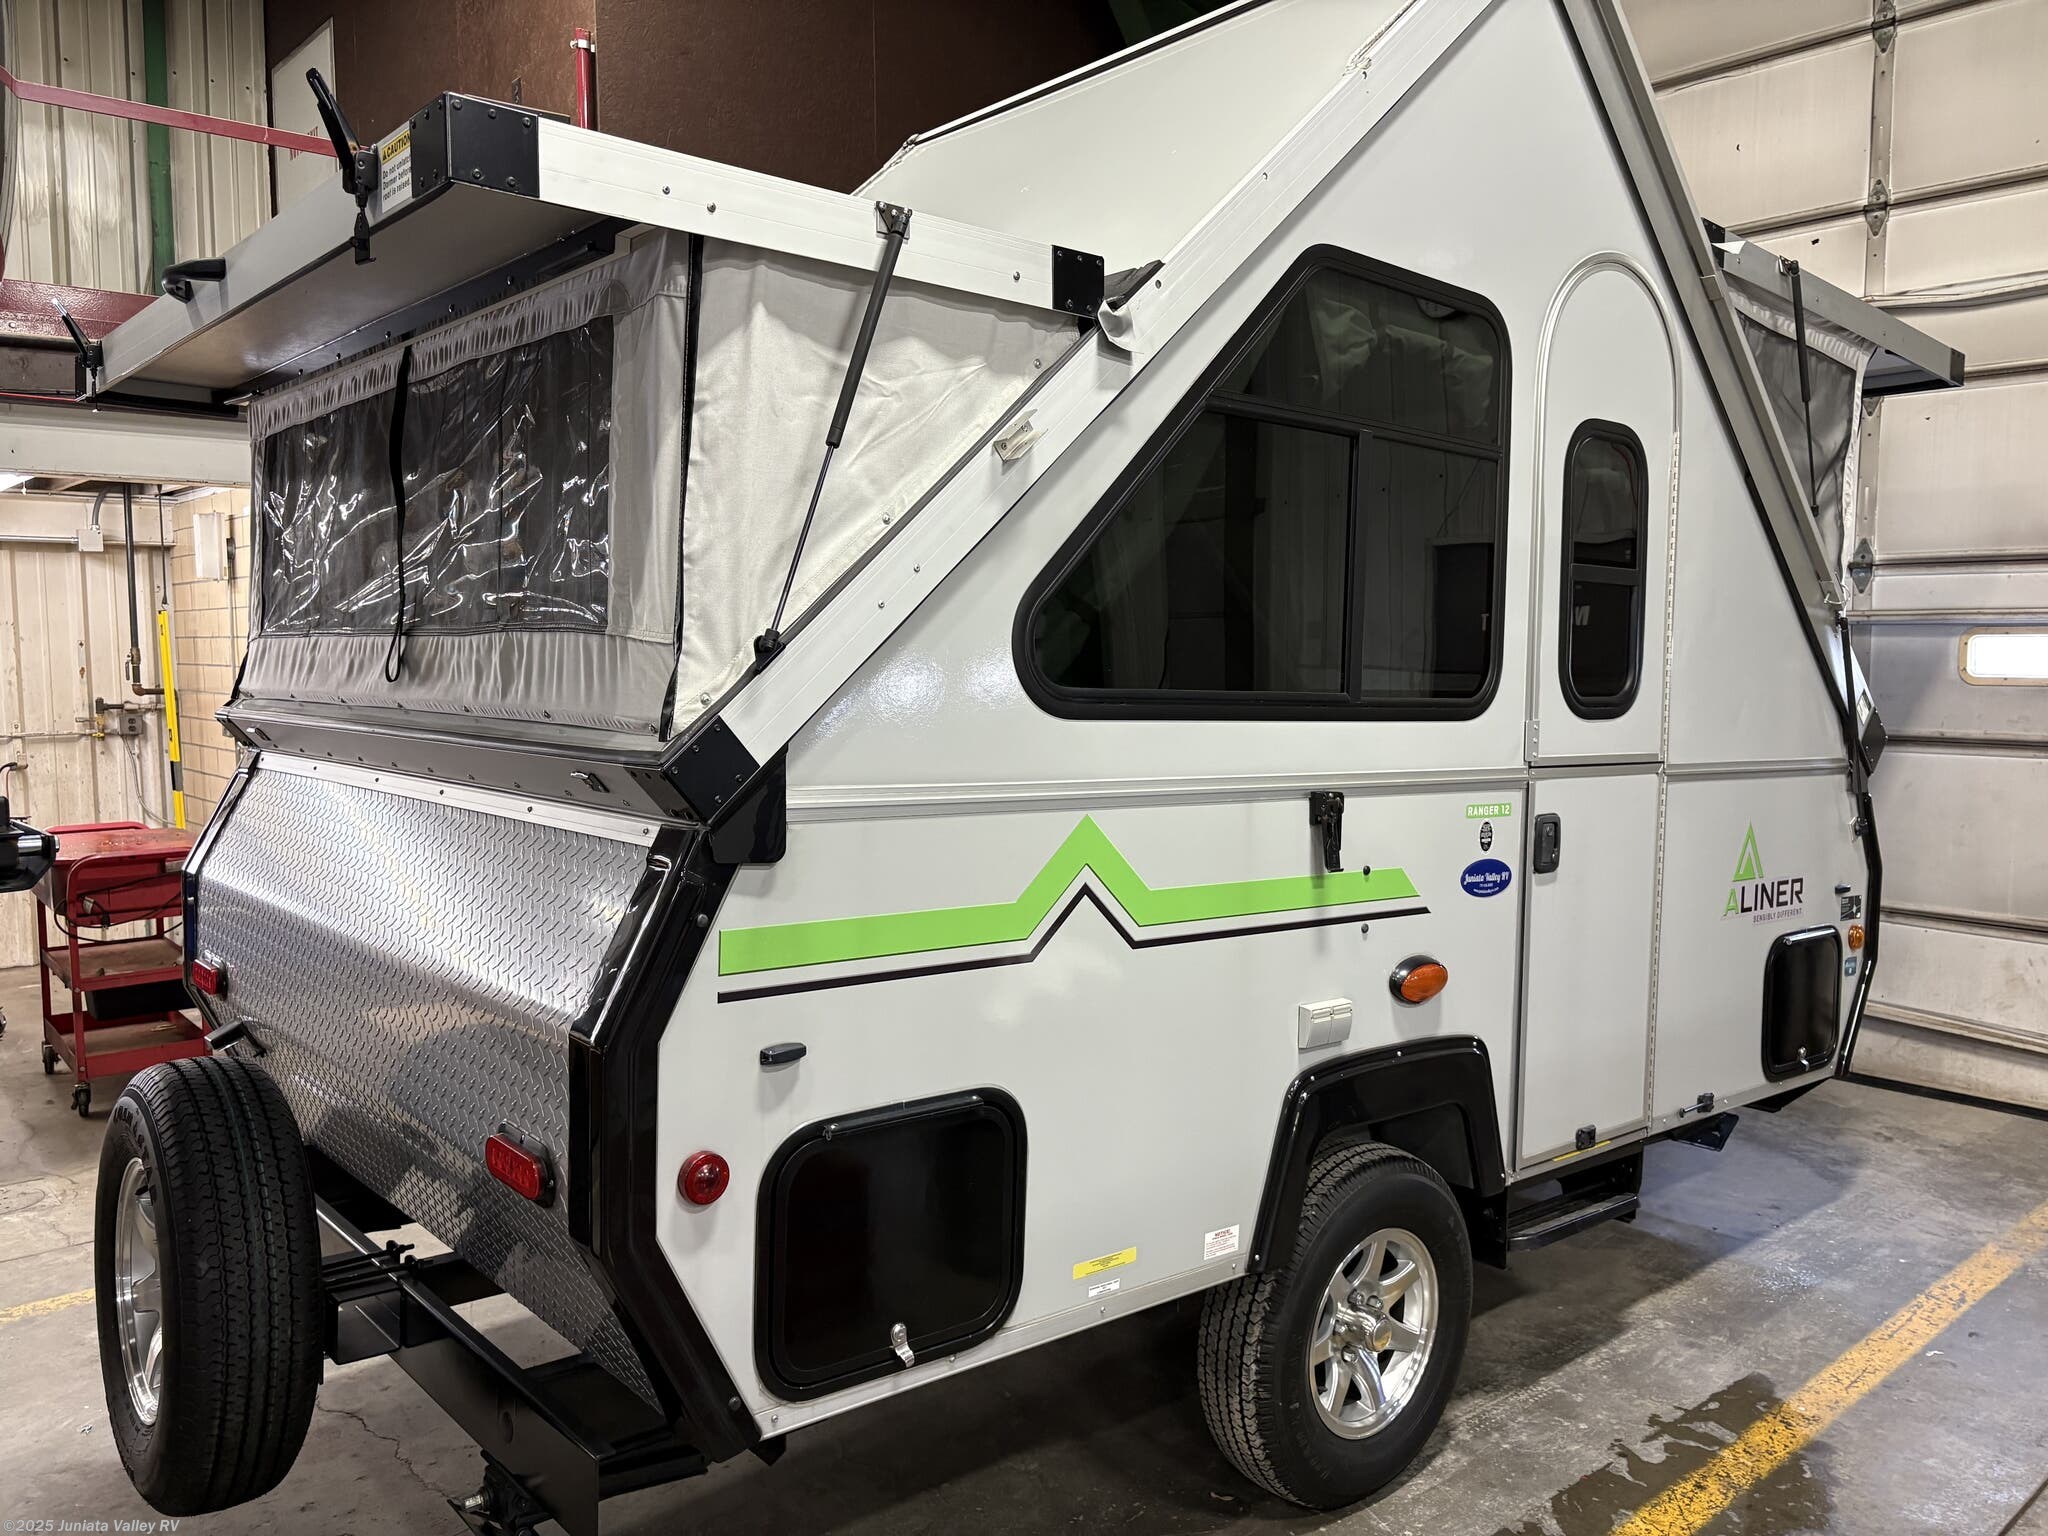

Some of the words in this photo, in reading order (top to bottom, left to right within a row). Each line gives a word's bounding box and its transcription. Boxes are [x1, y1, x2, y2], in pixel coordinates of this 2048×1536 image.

[1467, 805, 1499, 817] RANGER
[1501, 804, 1510, 815] 12
[1485, 872, 1500, 883] Valley
[1723, 878, 1803, 917] ALINER
[1753, 911, 1777, 923] SENSIBLY
[1777, 908, 1802, 920] DIFFERENT
